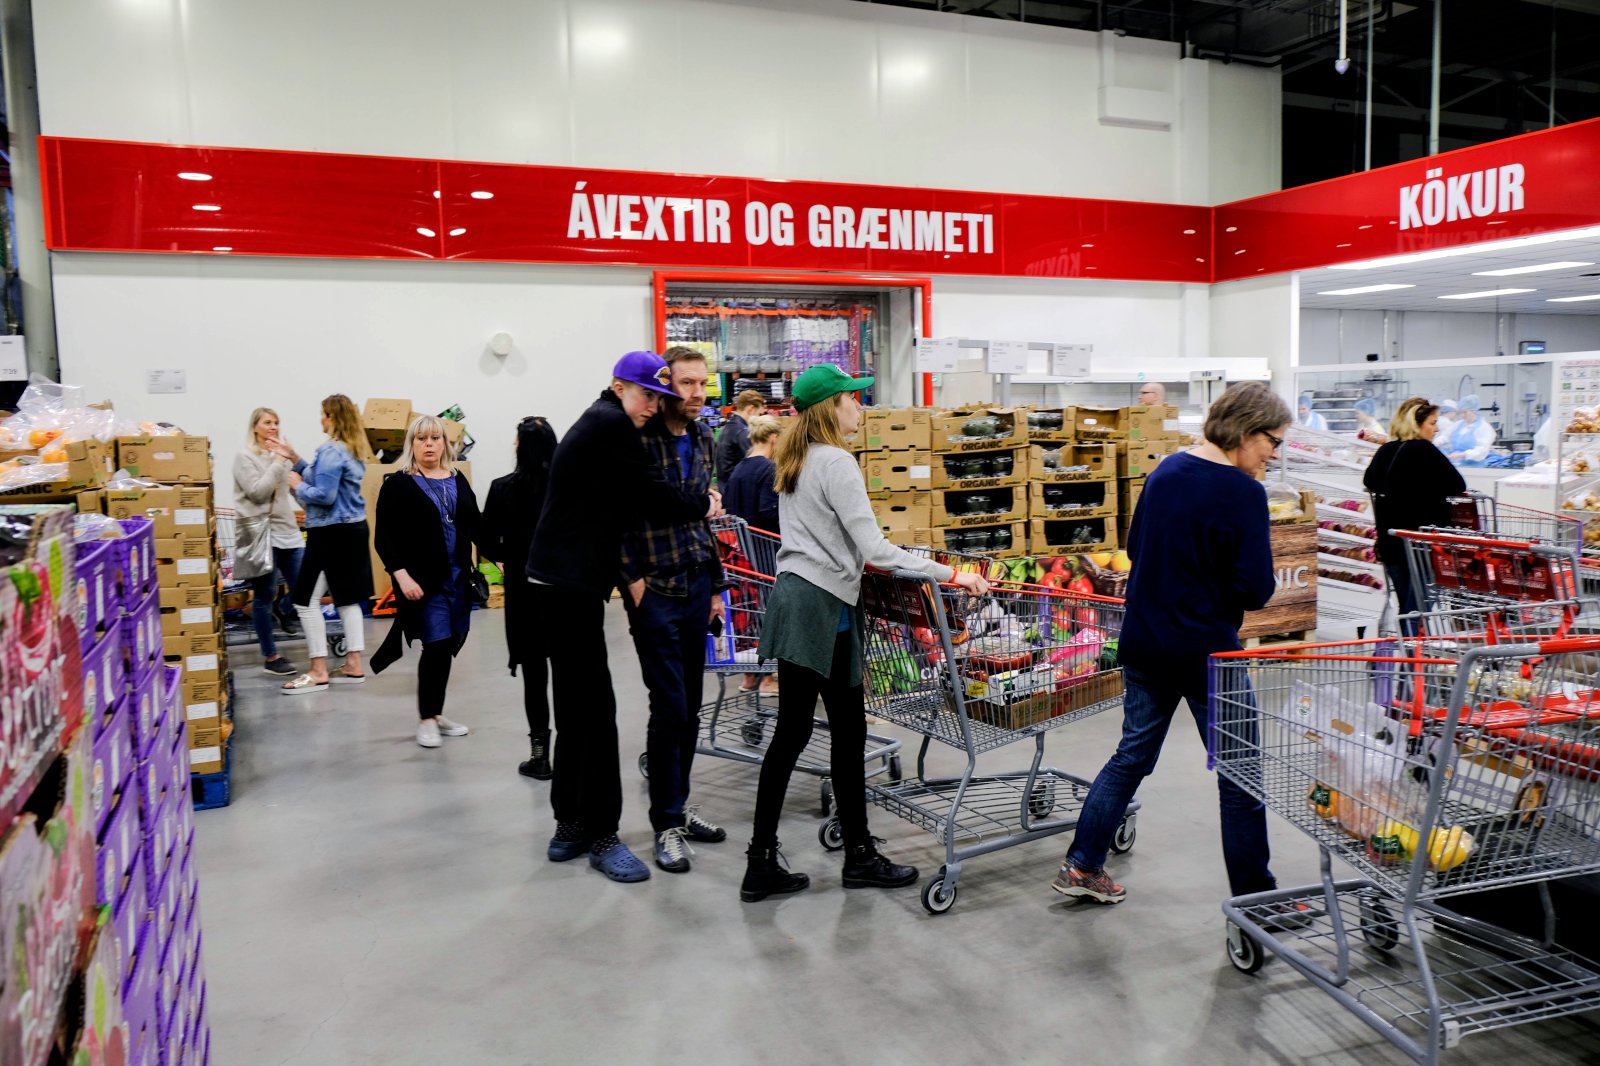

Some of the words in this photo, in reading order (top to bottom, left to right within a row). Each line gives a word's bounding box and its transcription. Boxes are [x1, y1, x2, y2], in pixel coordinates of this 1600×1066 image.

[1399, 162, 1525, 231] KÖKUR
[566, 181, 731, 244] ÁVEXTIR
[744, 200, 795, 246] OG
[807, 204, 994, 254] GRÆNMETI
[1082, 431, 1110, 440] ORGANIC
[961, 440, 1003, 451] ORGANIC
[1054, 473, 1092, 482] ORGANIC
[960, 478, 1001, 489] ORGANIC
[1056, 508, 1094, 518] ORGANIC
[960, 515, 1001, 526] ORGANIC
[1057, 545, 1095, 555] ORGANIC
